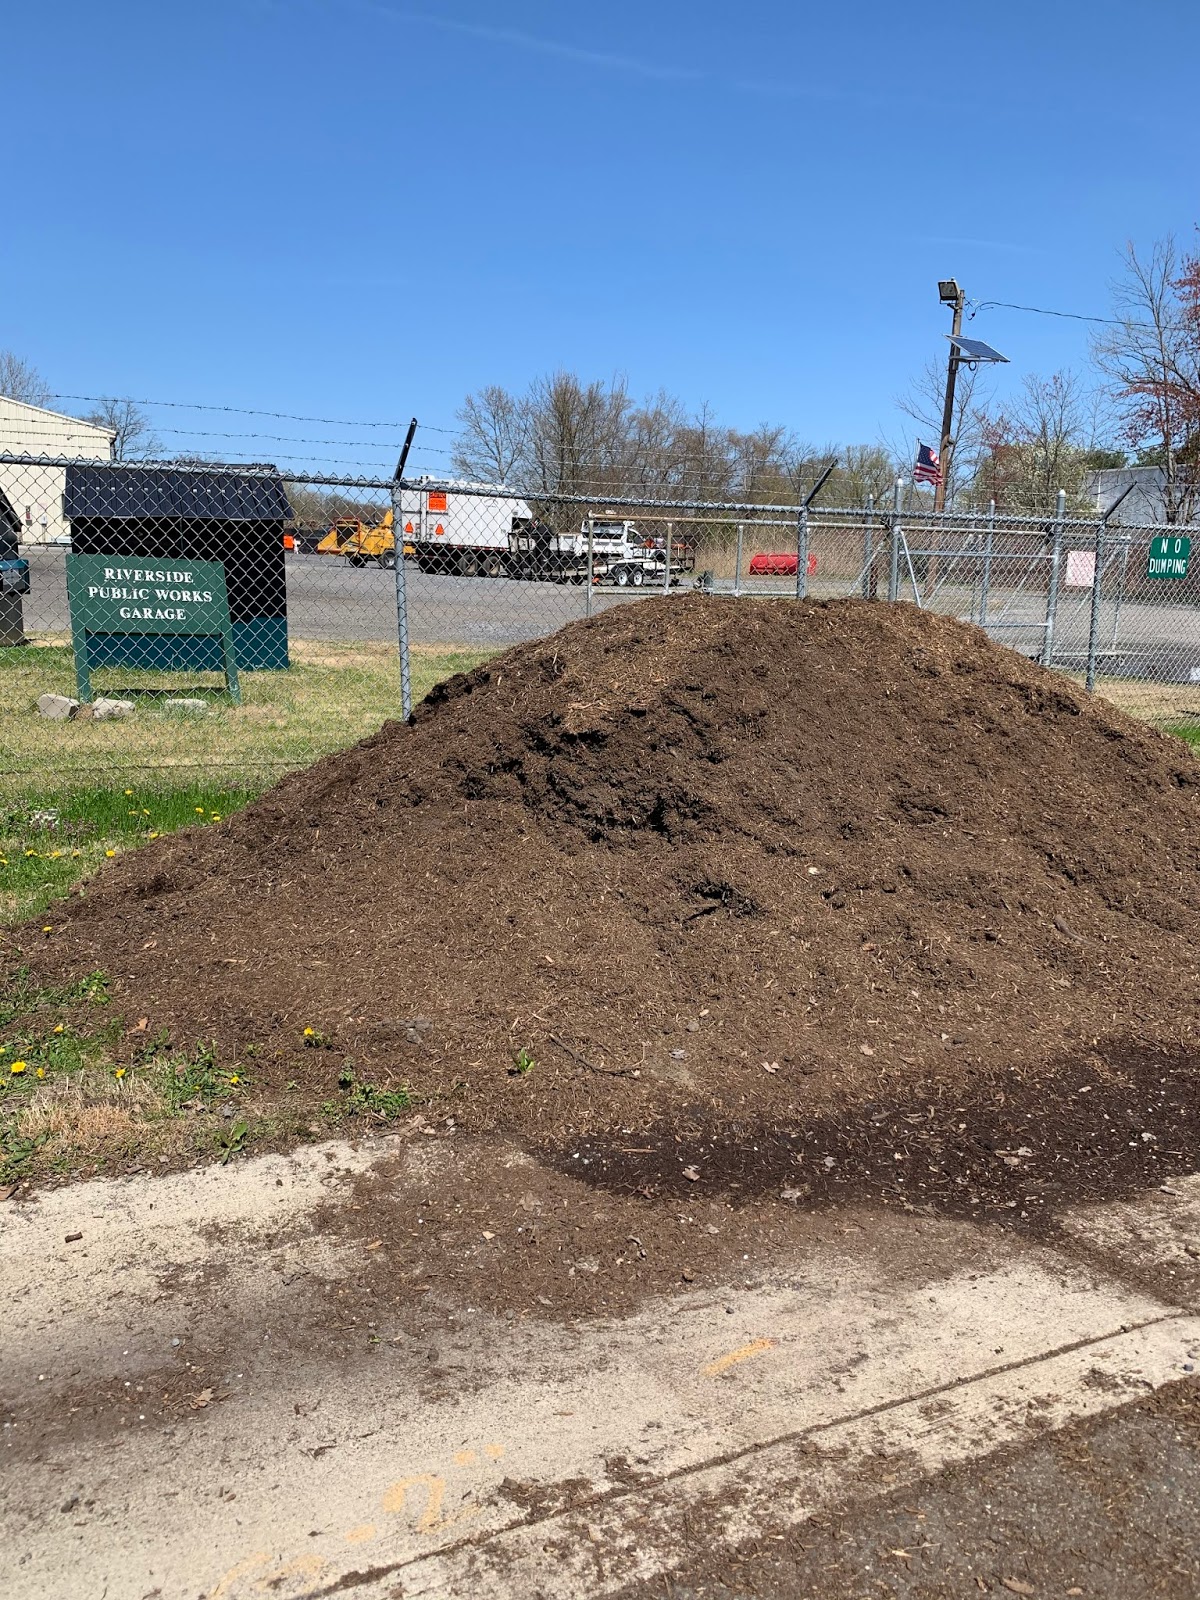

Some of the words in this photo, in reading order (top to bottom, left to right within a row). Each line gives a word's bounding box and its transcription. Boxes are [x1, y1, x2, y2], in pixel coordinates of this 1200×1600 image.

[1160, 538, 1182, 554] NO
[1148, 558, 1187, 575] DUMPING
[103, 567, 194, 583] RIVERSIDE
[88, 586, 150, 600] PUBLIC
[154, 588, 213, 602] WORKS
[119, 606, 187, 620] GARAGE
